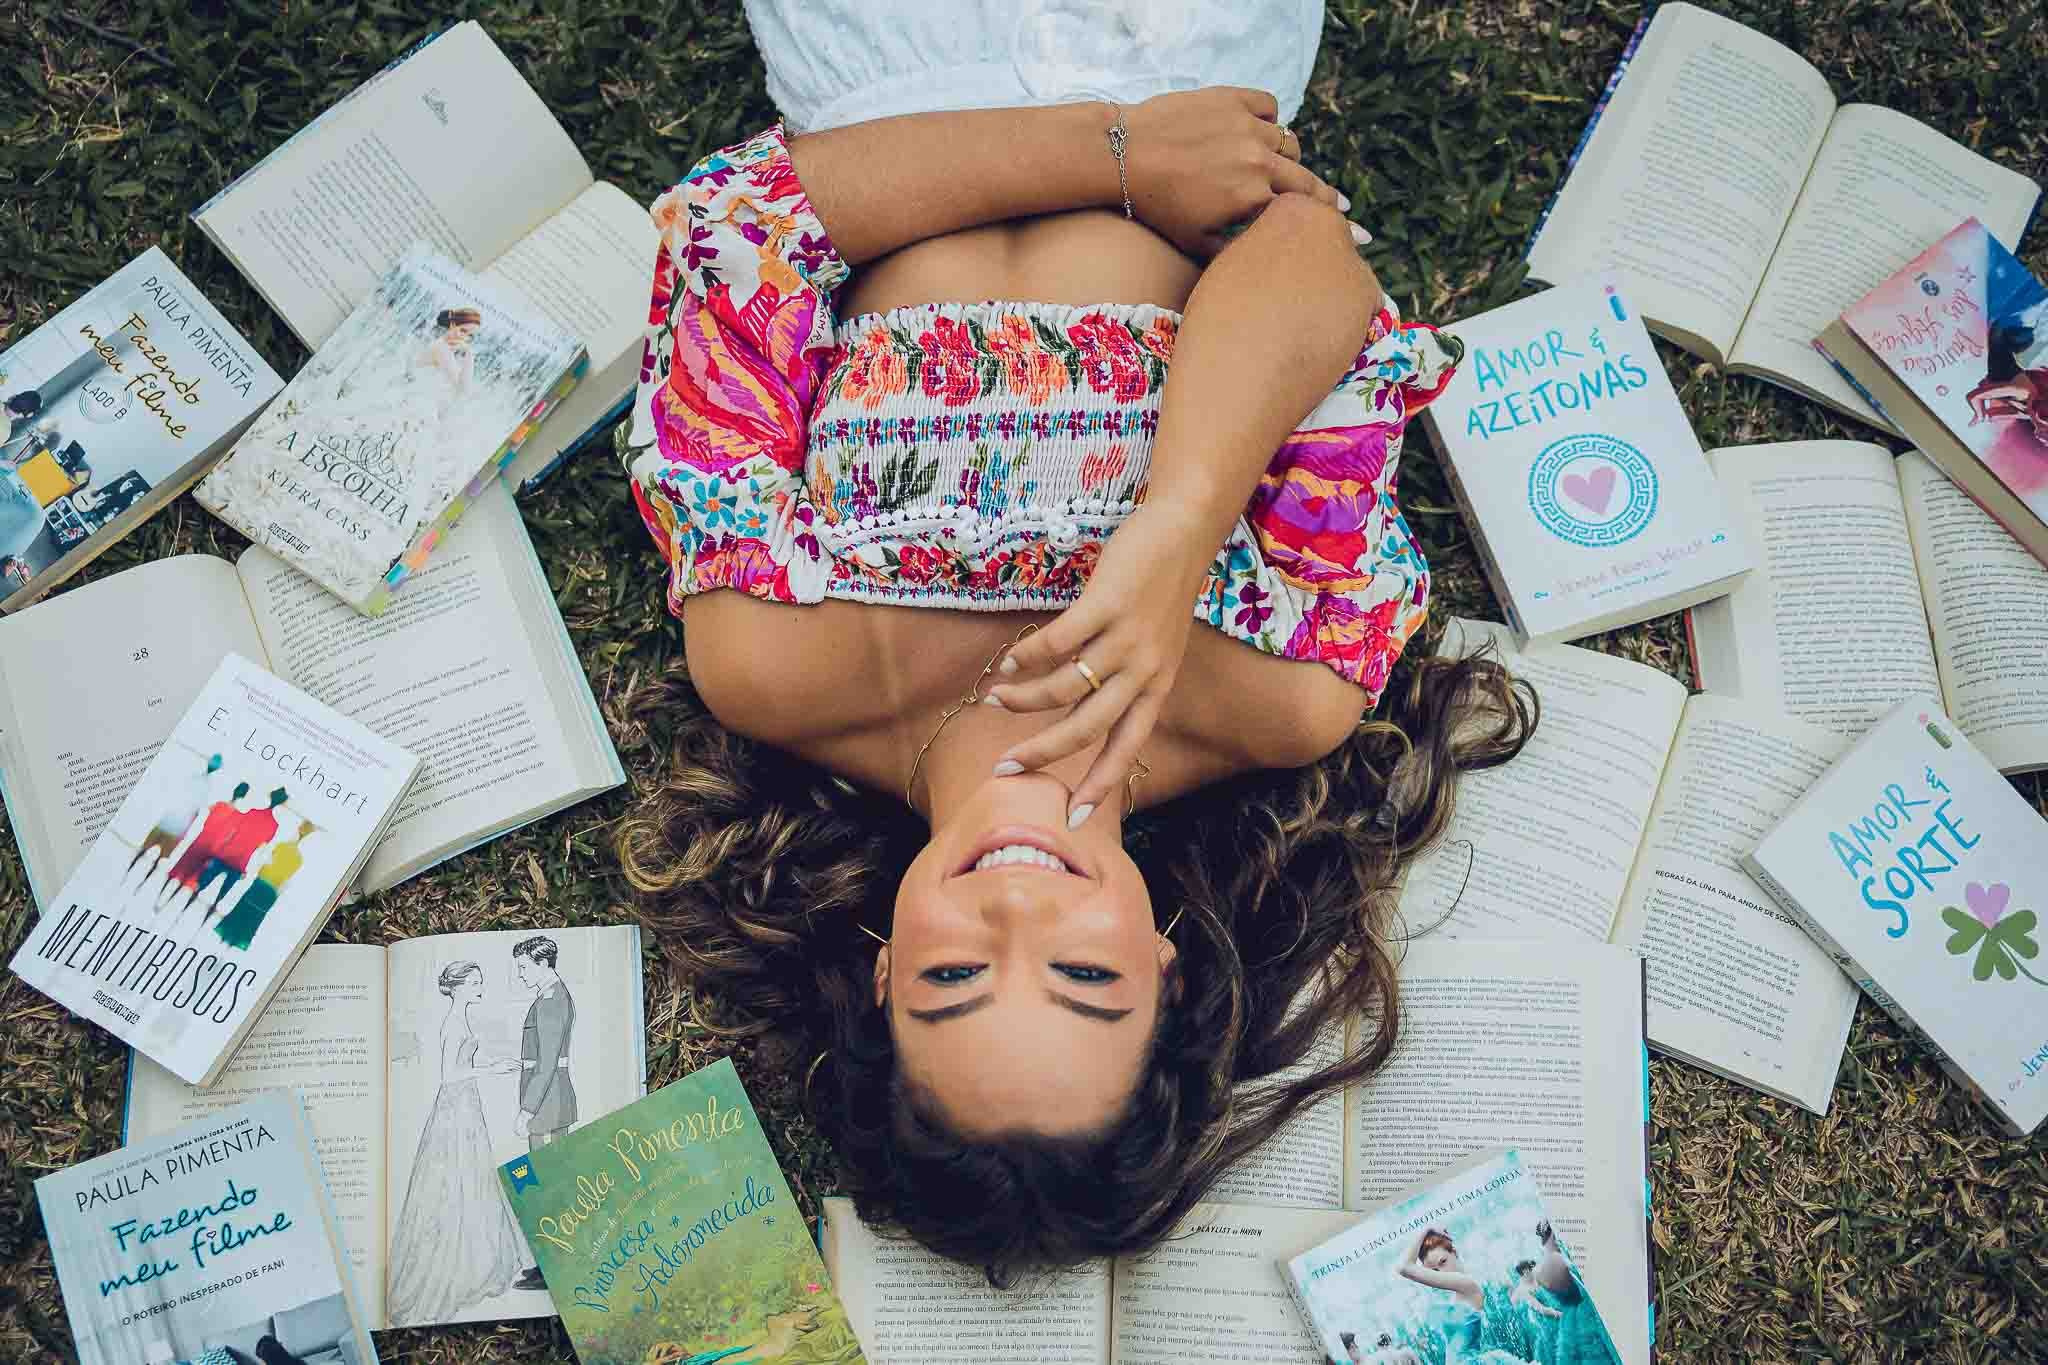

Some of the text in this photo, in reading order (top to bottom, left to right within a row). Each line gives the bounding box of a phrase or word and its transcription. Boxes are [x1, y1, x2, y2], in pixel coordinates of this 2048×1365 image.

[120, 312, 201, 405] Fazendo
[142, 275, 191, 331] PAULA
[188, 327, 253, 398] PIMENTA
[1473, 327, 1606, 393] AMOR &
[79, 324, 186, 439] meu filme
[82, 379, 128, 420] LADO B
[277, 431, 297, 451] A
[298, 443, 409, 525] ESCOLHA
[266, 468, 321, 511] KIERA
[325, 506, 371, 542] CASS
[132, 647, 151, 663] 28
[242, 727, 371, 816] Lockhart
[1827, 782, 1931, 880] AMOR
[1924, 765, 1951, 794] &
[1654, 867, 1685, 883] REGRAS
[1685, 877, 1698, 886] DA
[1698, 881, 1717, 893] LINA
[1717, 888, 1737, 901] PARA
[1736, 897, 1764, 912] ANDAR
[1763, 908, 1774, 917] DE
[1861, 799, 1982, 940] SORTE
[37, 902, 258, 1025] MENTIROSOS
[75, 1166, 160, 1214] PAULA
[166, 1123, 276, 1181] PIMENTA
[535, 1170, 615, 1256] Paula
[607, 1095, 745, 1182] Pimenta
[100, 1211, 293, 1298] meu filme
[111, 1178, 258, 1253] Fazendo
[632, 1175, 775, 1313] Adormecida
[1196, 1225, 1230, 1234] PLAYLIST
[1311, 1252, 1353, 1280] TRINTA
[1397, 1202, 1448, 1236] GAROTAS
[1482, 1166, 1522, 1193] COROA
[121, 1258, 286, 1327] O ROTEIRO INESPERADO DE FANI
[574, 1218, 655, 1313] Princesa
